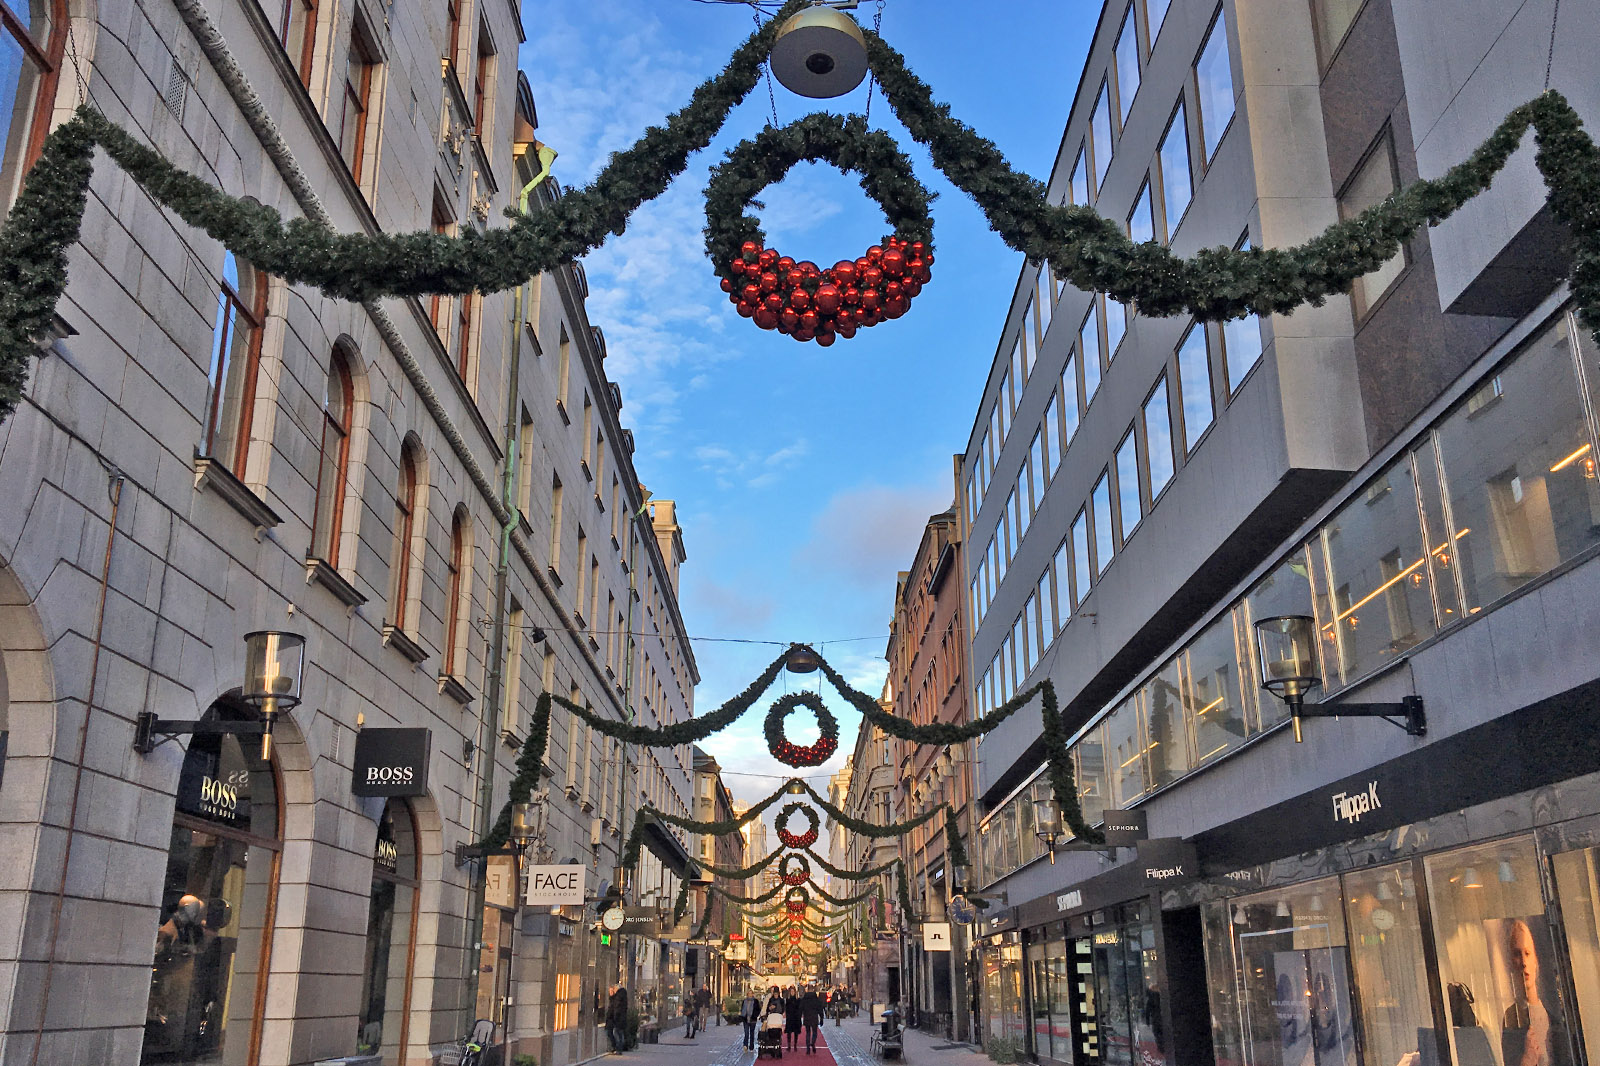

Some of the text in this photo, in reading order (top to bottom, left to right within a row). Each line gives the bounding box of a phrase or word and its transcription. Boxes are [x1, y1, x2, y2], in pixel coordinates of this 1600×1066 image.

[367, 767, 413, 781] BOSS
[200, 776, 237, 810] BOSS
[1332, 781, 1381, 824] Filippa K
[378, 839, 397, 861] BOSS
[535, 873, 578, 890] FACE
[1146, 865, 1184, 880] Filippa K
